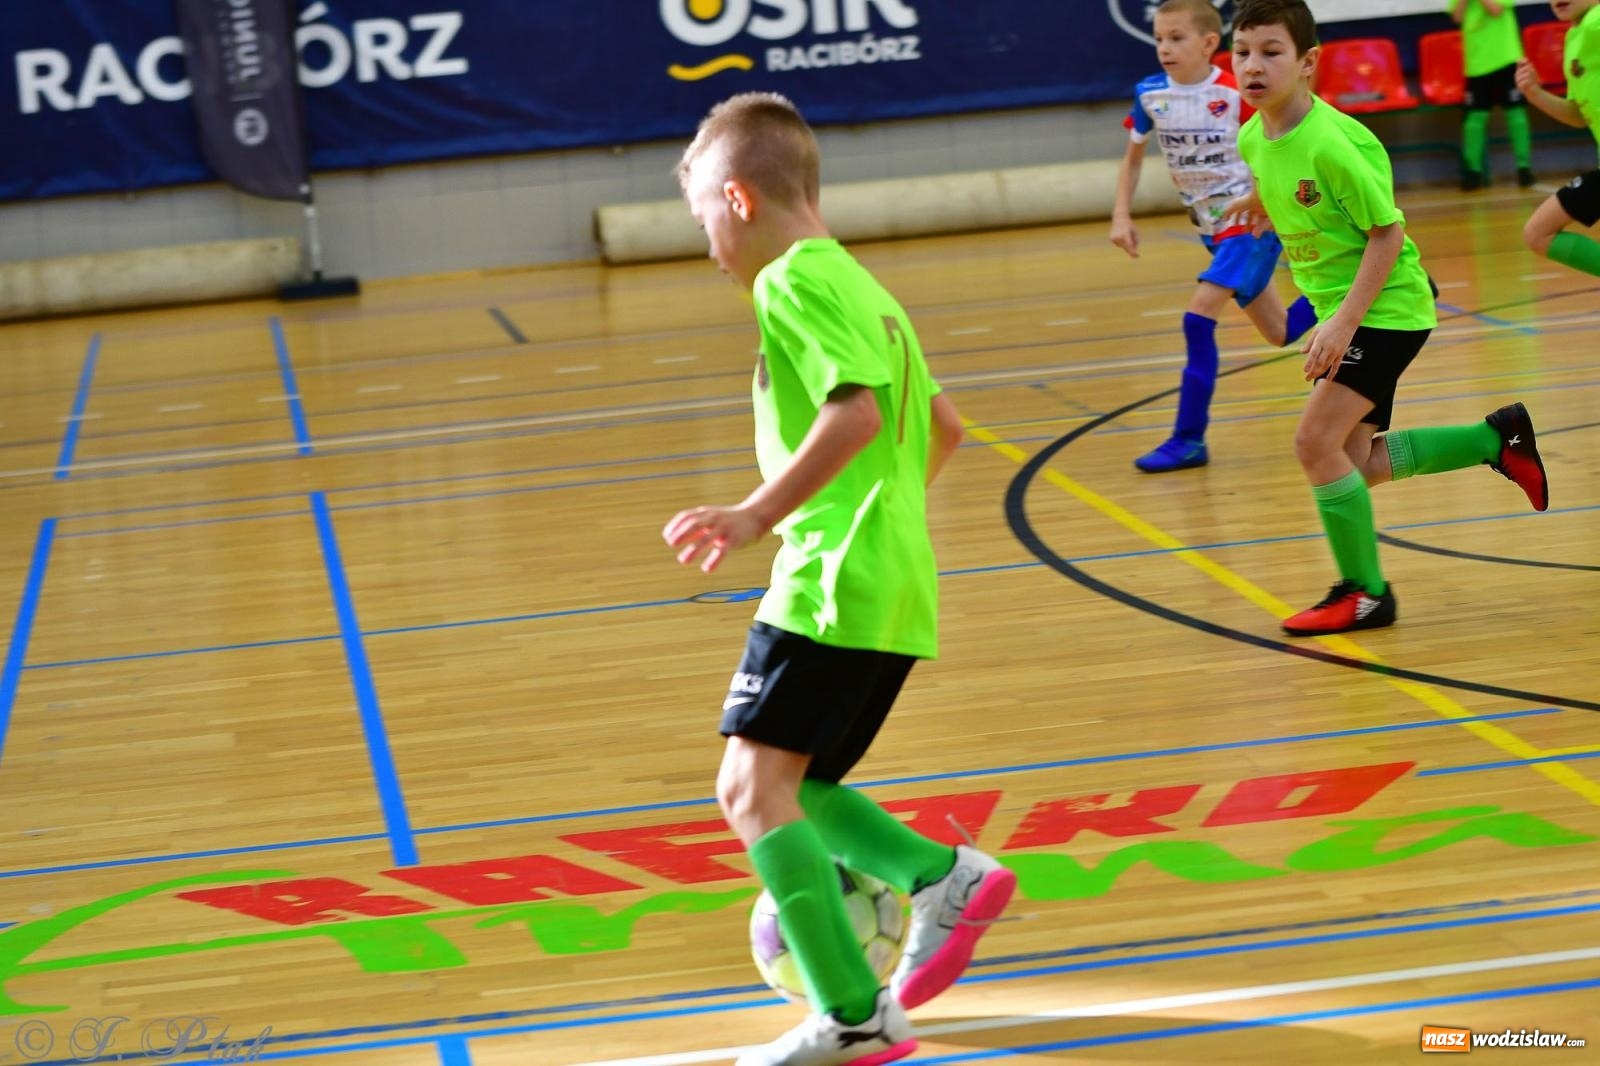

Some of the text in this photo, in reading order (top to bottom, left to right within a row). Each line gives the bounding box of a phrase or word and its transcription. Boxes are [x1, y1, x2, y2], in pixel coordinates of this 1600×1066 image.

[15, 2, 469, 115] RACÓRZ
[766, 34, 921, 72] RACIBÓRZ
[881, 315, 910, 445] 7
